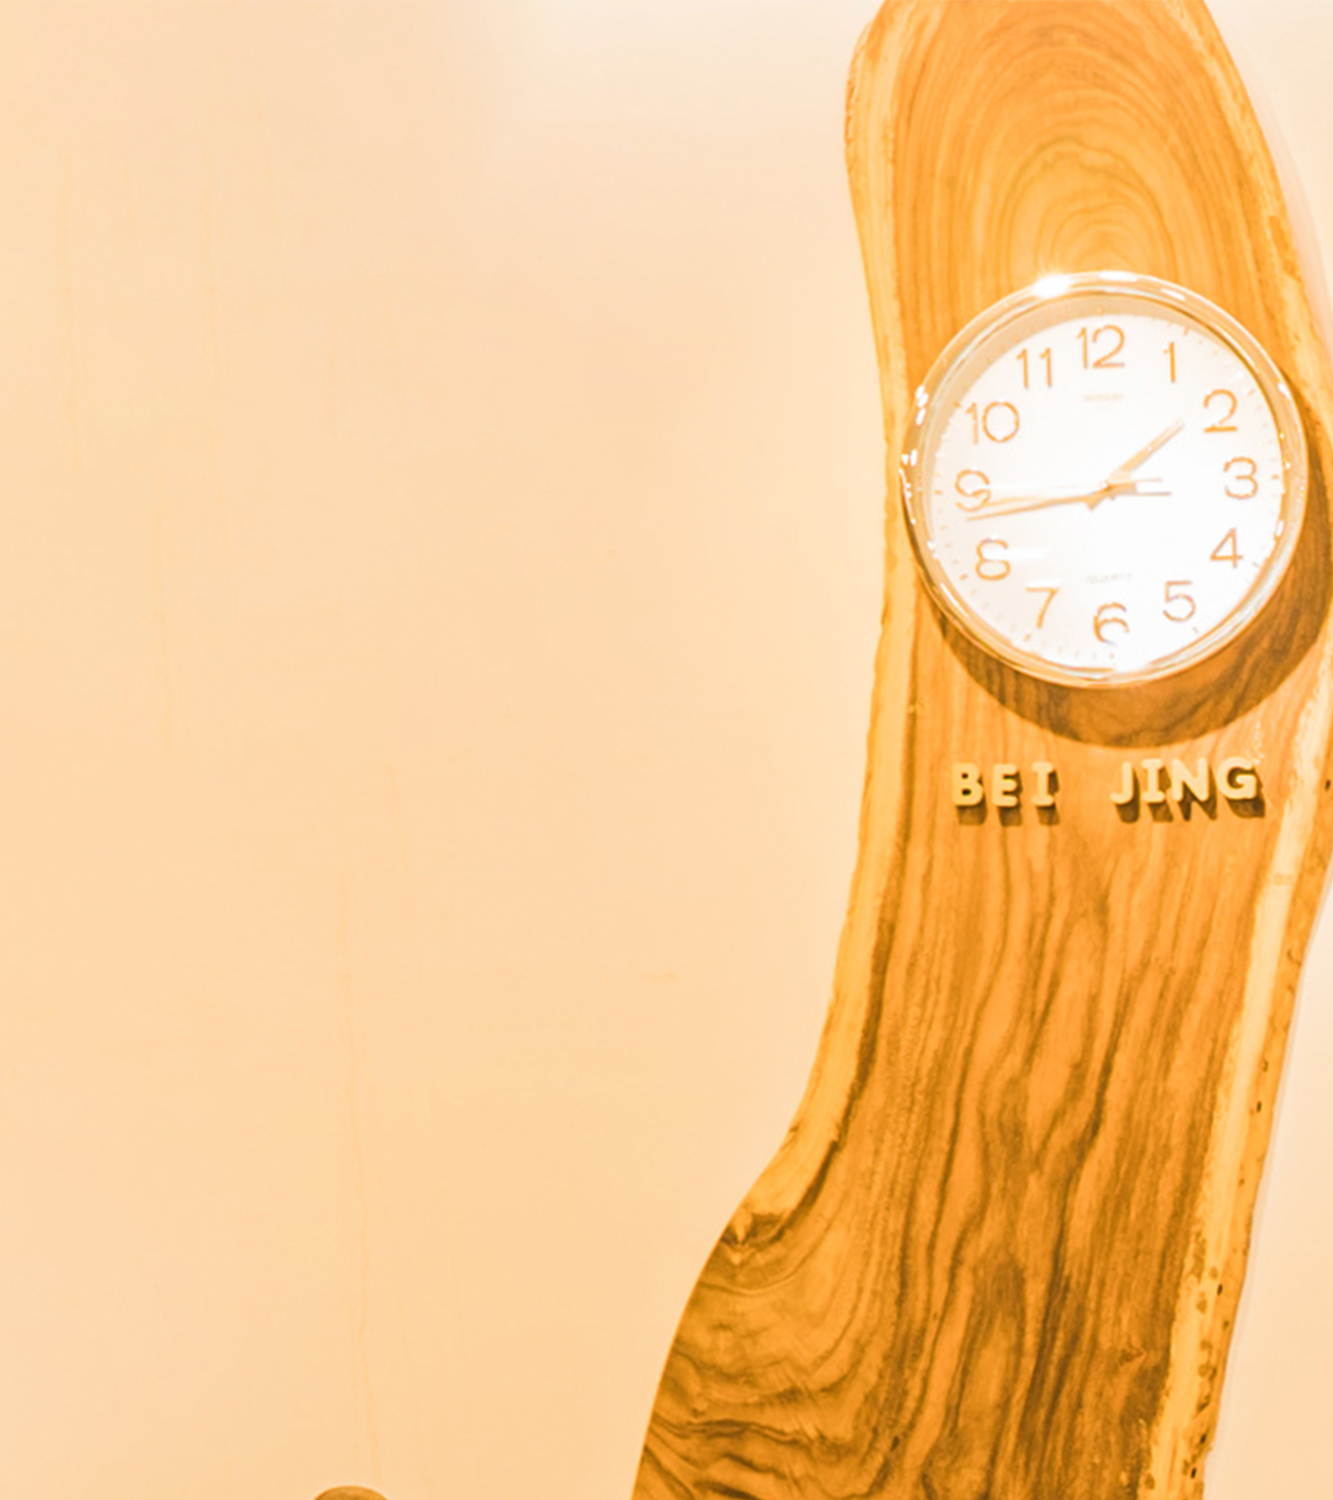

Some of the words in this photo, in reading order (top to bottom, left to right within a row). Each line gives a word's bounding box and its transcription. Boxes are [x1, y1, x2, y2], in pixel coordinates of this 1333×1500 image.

[1077, 324, 1126, 368] 12
[1163, 341, 1177, 383] 1
[1016, 348, 1053, 389] 11
[966, 401, 1020, 445] 10
[1204, 389, 1238, 434] 2
[955, 469, 991, 511] 9
[1224, 457, 1259, 499] 3
[976, 539, 1010, 580] 8
[1211, 528, 1244, 568] 4
[1027, 587, 1059, 629] 7
[1163, 580, 1196, 622] 5
[1093, 602, 1130, 644] 6
[950, 762, 1056, 807] BEI
[1110, 756, 1260, 805] JING
